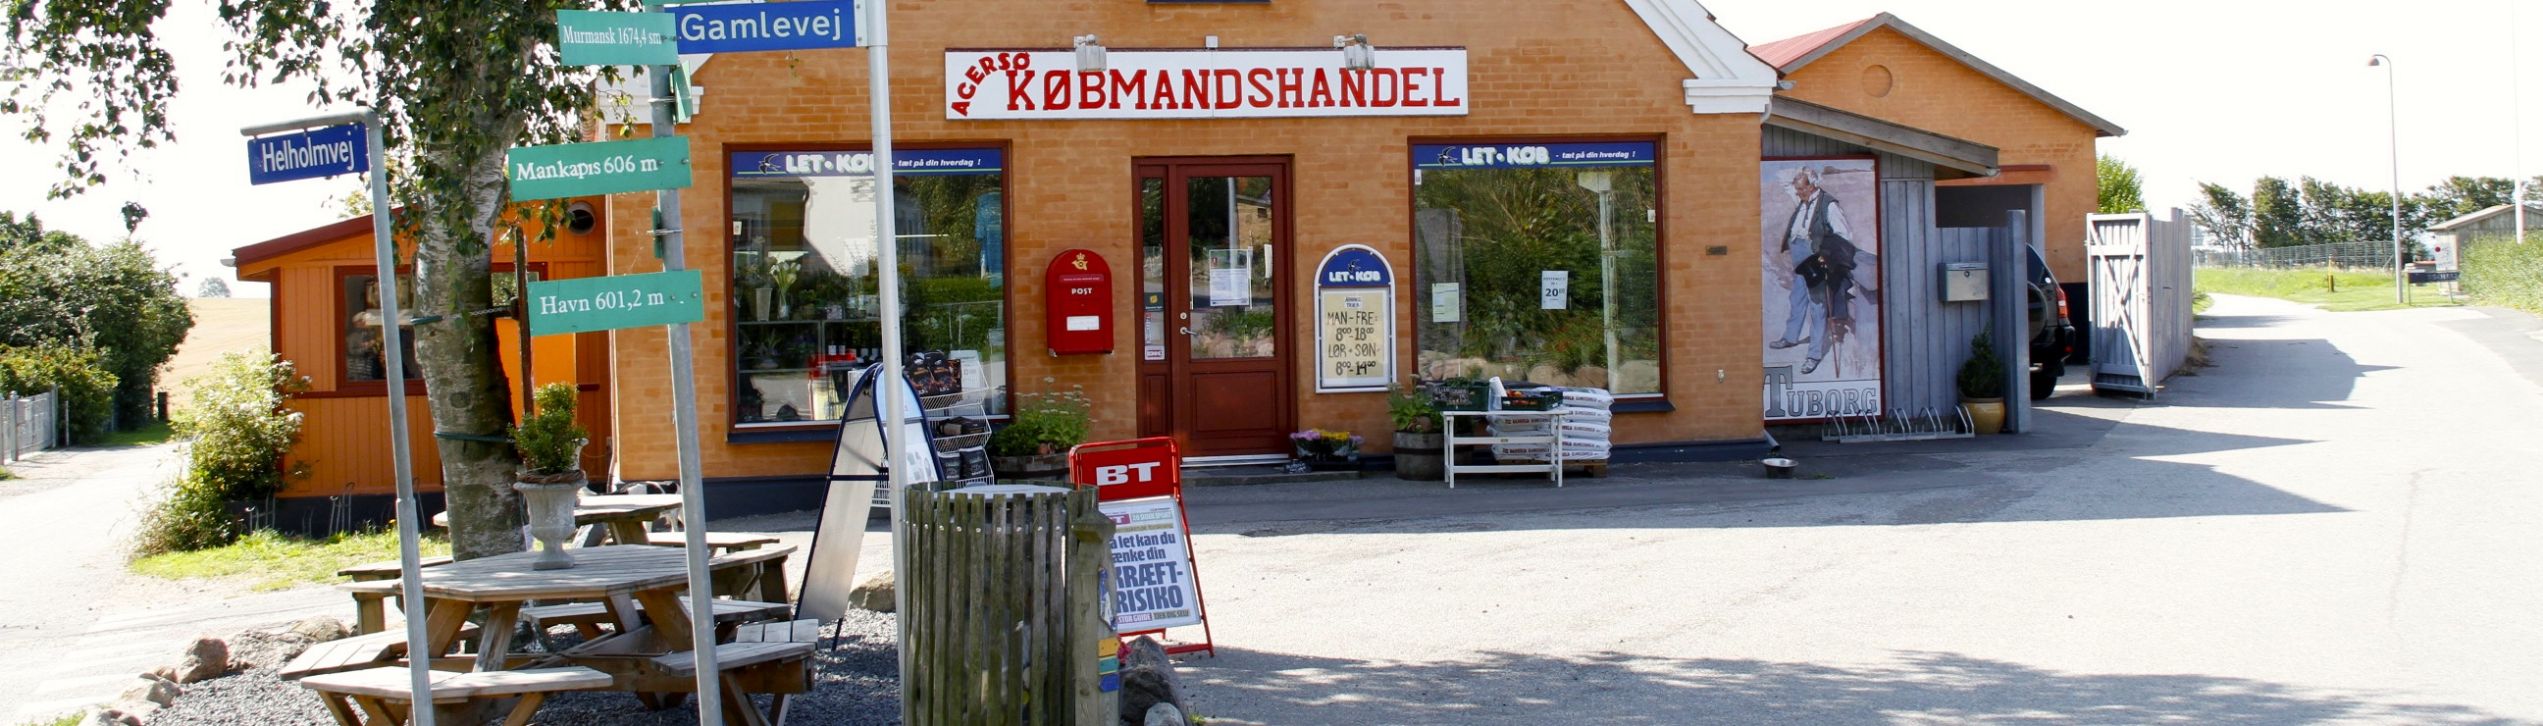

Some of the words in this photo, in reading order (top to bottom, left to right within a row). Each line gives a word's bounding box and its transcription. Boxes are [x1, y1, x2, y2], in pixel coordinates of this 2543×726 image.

[563, 25, 616, 44] Murmansk
[619, 27, 647, 47] 1674,4
[649, 33, 661, 44] sm
[681, 8, 842, 41] Gamlevej
[1006, 67, 1461, 111] KØBMANDSHANDEL
[262, 131, 355, 172] Helholmvej
[898, 159, 912, 167] tæt
[913, 158, 924, 168] på
[925, 158, 939, 167] din
[940, 158, 974, 168] hverdag
[1576, 151, 1586, 161] på
[1587, 151, 1599, 159] din
[1600, 150, 1630, 160] hverdag
[604, 155, 636, 174] 606
[640, 157, 658, 172] m
[539, 295, 590, 315] Havn
[595, 289, 641, 311] 601,2
[648, 291, 664, 306] m
[1071, 287, 1093, 295] POST
[1763, 365, 1878, 418] TUBORG
[1095, 461, 1161, 486] BT
[1118, 535, 1136, 548] let
[1136, 534, 1159, 547] kan
[1160, 531, 1177, 544] du
[1112, 549, 1145, 563] ænke
[1146, 547, 1166, 560] din
[1116, 585, 1184, 613] RISIKO
